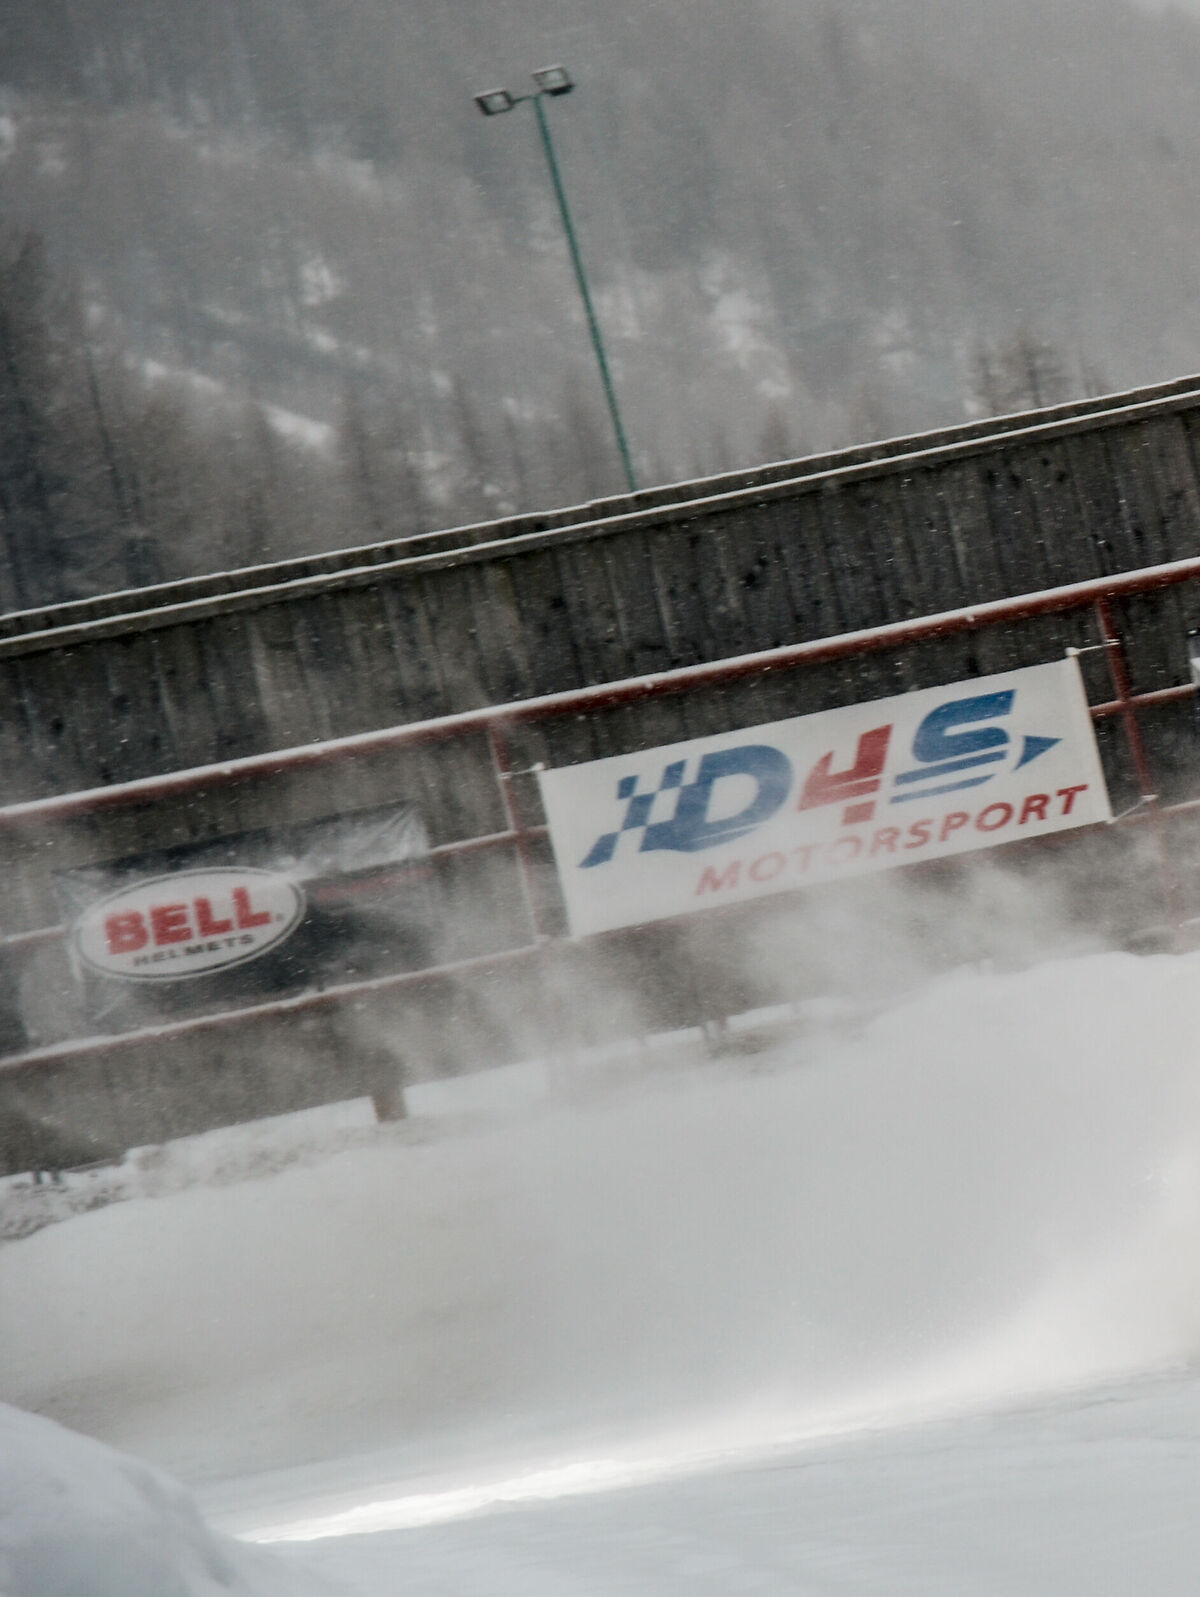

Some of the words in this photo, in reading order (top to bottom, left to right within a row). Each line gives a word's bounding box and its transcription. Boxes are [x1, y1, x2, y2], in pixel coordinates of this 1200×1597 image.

[638, 689, 1017, 855] D4S
[695, 784, 1089, 896] MOTORSPORT
[105, 886, 272, 956] BELL
[132, 934, 254, 966] HELMETS
